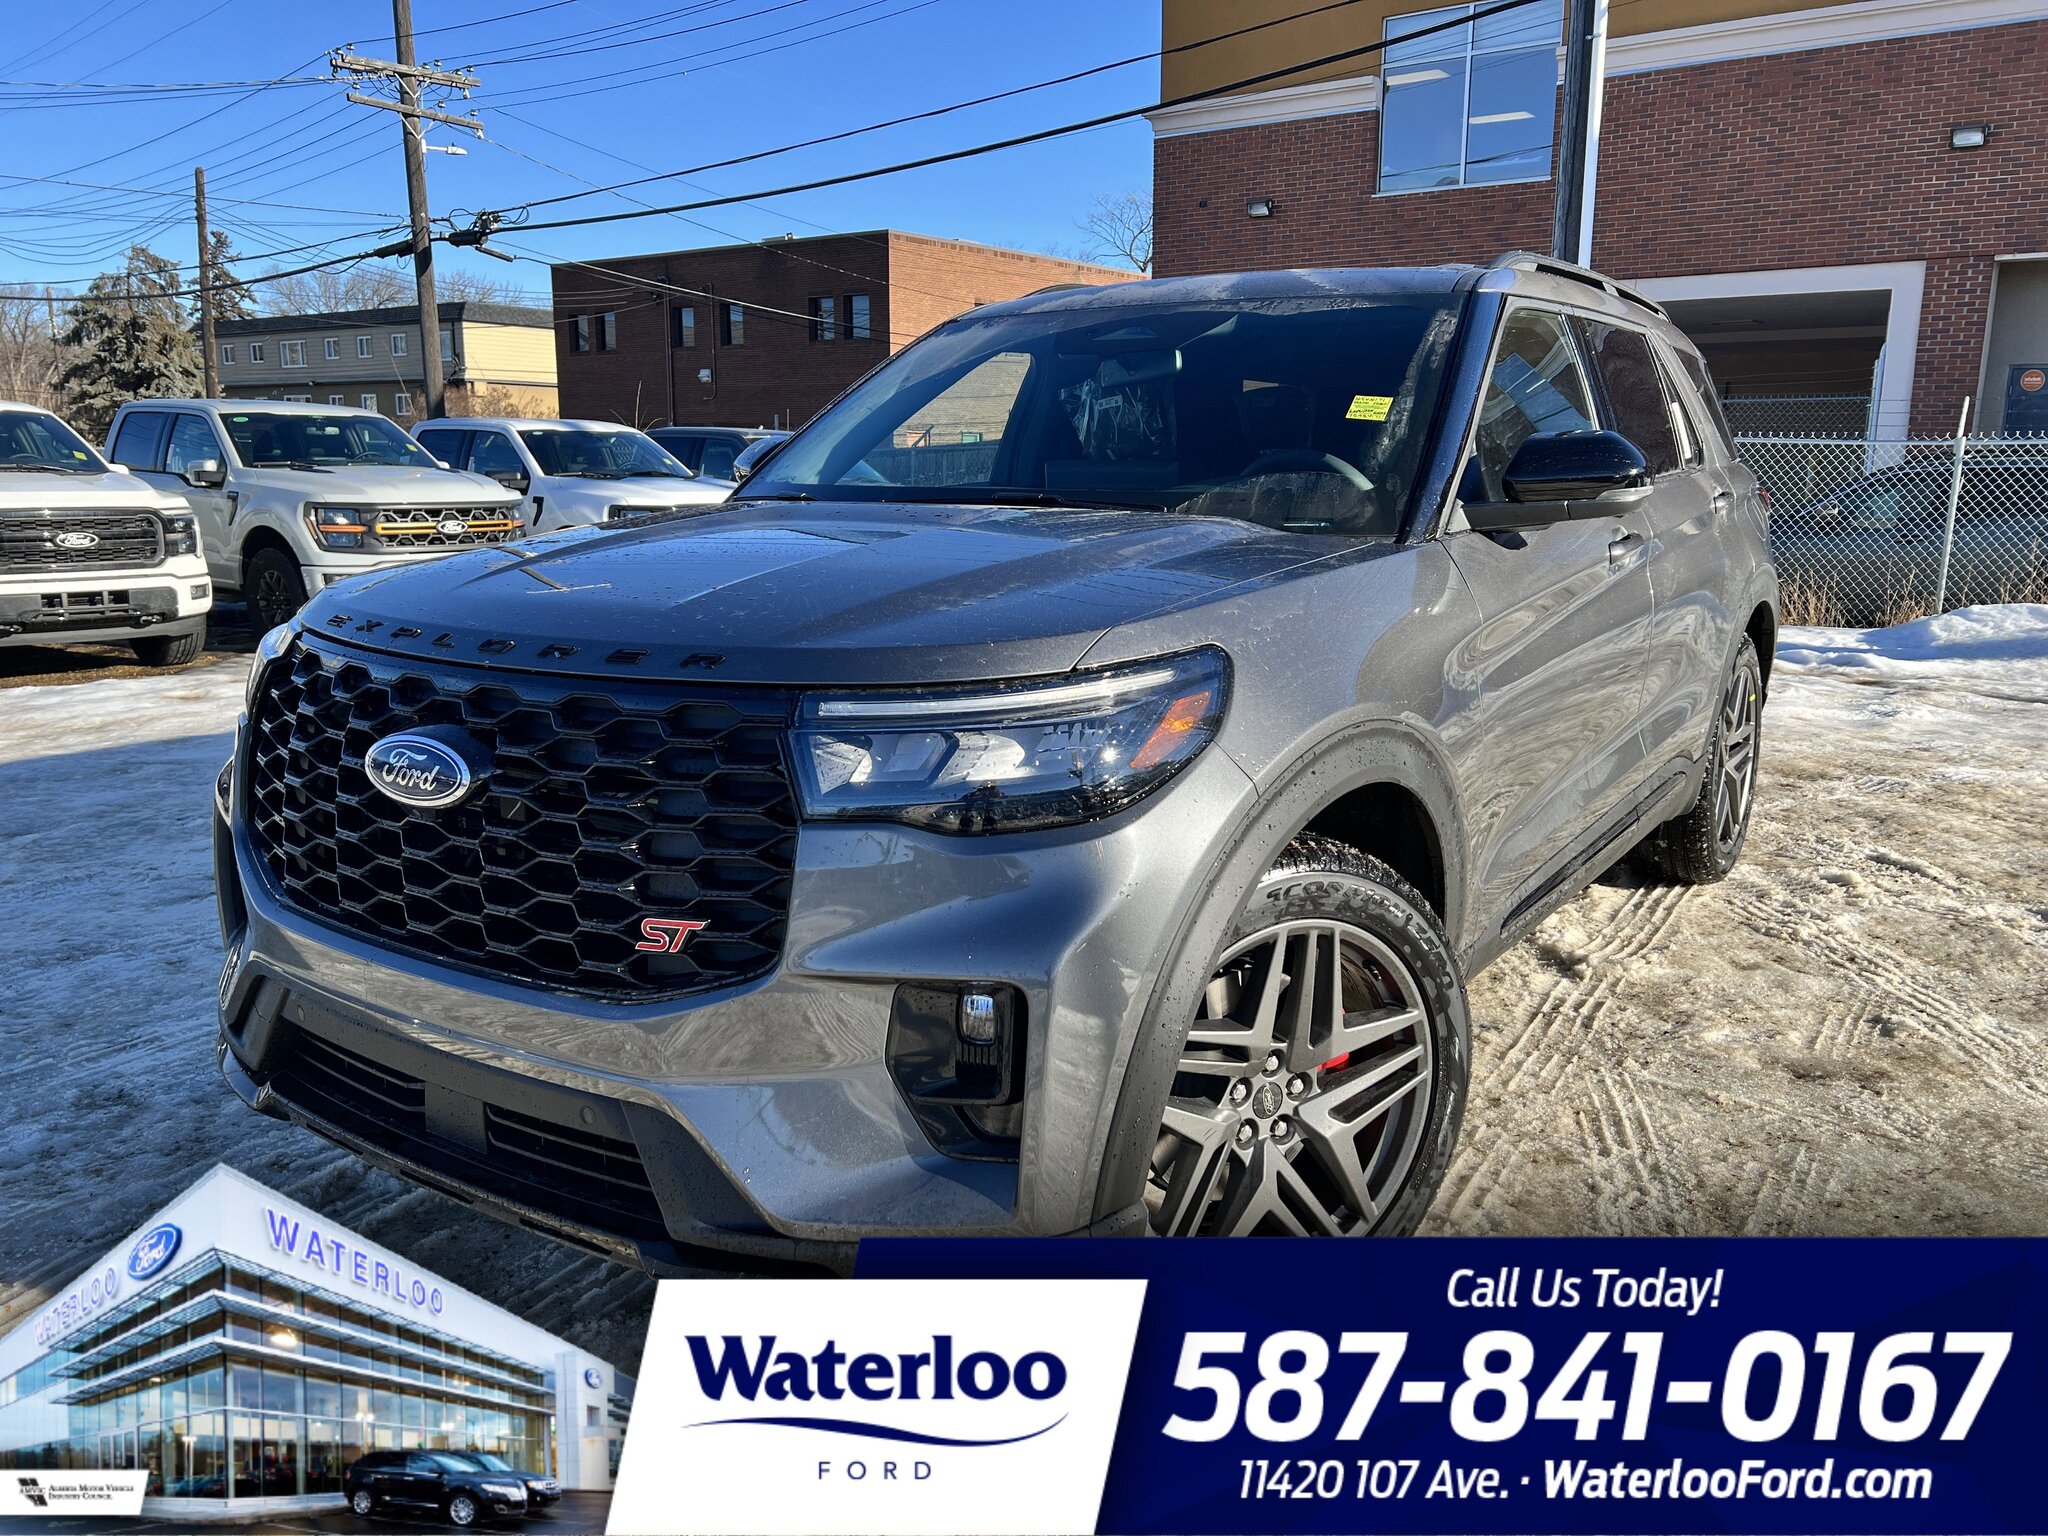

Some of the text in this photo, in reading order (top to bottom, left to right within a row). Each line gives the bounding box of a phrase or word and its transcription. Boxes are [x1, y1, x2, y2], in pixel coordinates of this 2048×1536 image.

[64, 534, 91, 545] Ford
[326, 613, 727, 670] EXPLORER
[382, 748, 441, 791] Ford
[635, 917, 711, 953] ST
